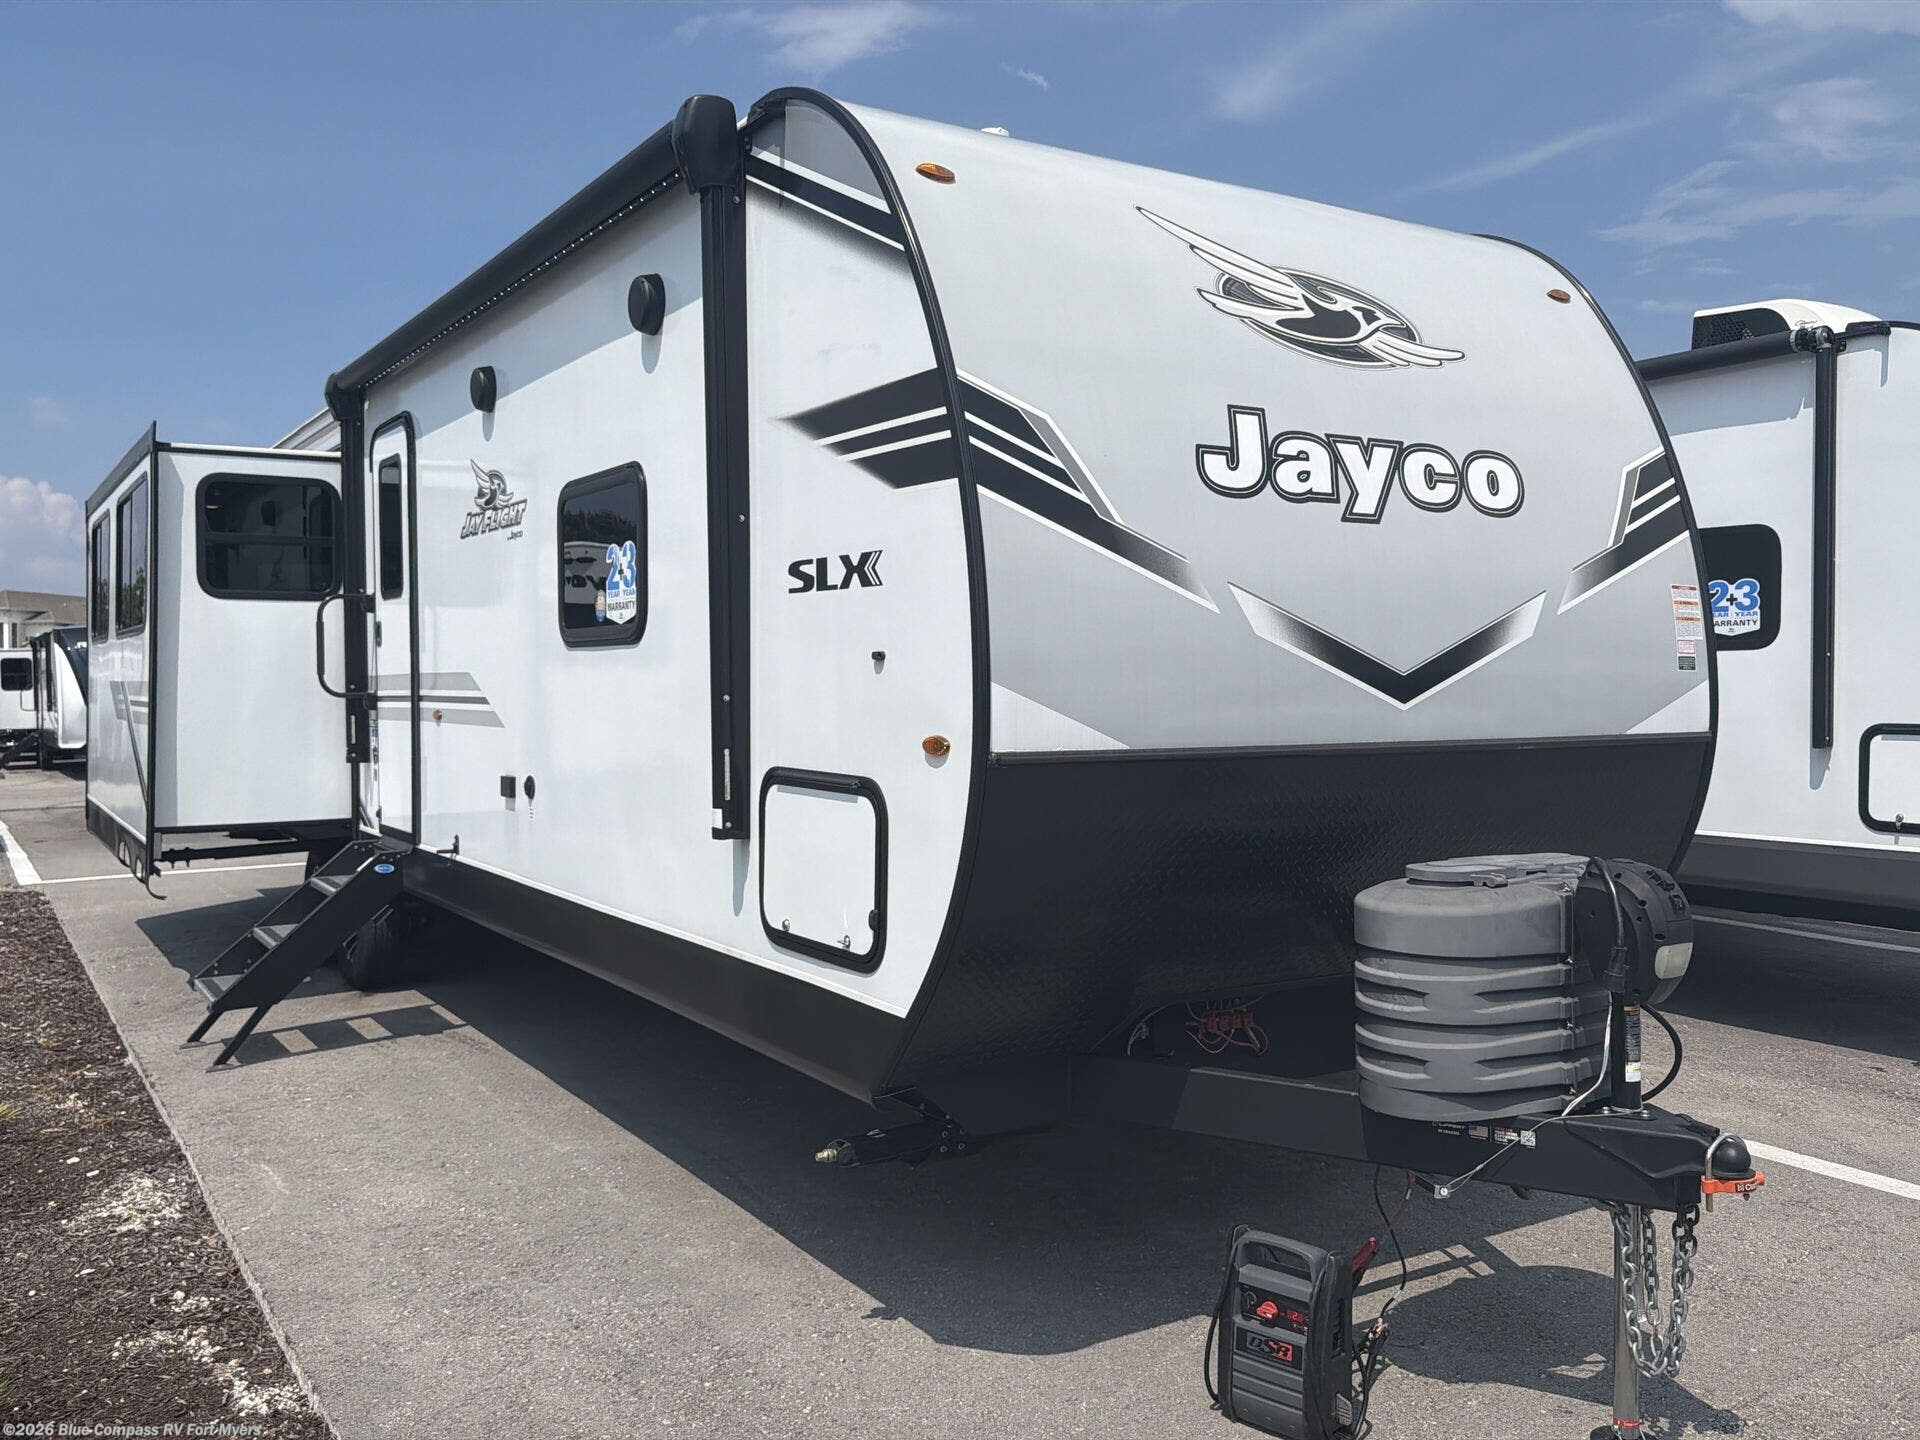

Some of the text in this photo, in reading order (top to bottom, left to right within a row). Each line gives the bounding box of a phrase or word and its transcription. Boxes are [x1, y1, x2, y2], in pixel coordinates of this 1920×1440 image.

[1195, 403, 1525, 525] Jayco
[787, 550, 883, 594] SLX
[608, 588, 635, 599] YEAR YEAR
[608, 601, 636, 612] WARRANTY
[1714, 619, 1758, 627] ARRANTY
